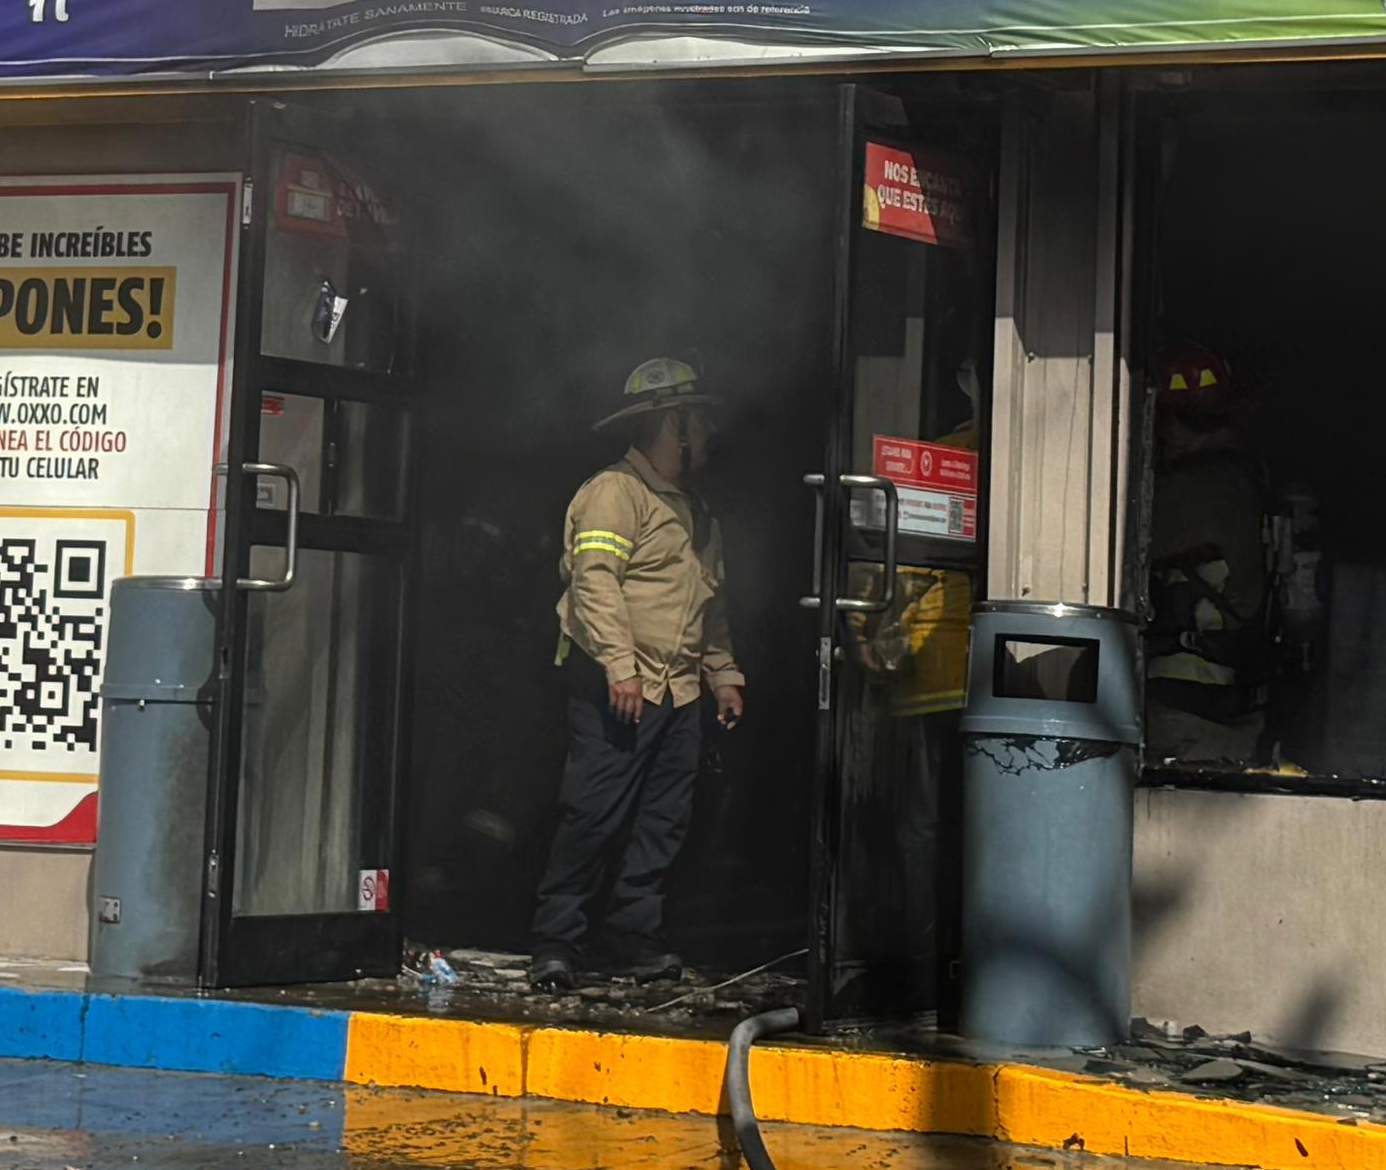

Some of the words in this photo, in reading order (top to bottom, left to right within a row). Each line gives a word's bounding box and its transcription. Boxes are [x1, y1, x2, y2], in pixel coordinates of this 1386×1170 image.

[364, 1, 467, 20] SANAMENTE
[884, 160, 908, 187] NOS
[877, 184, 901, 209] QUE
[30, 226, 152, 259] INCREÍBLES
[75, 375, 99, 398] EN
[34, 430, 54, 452] EL
[58, 425, 127, 453] CÓDIGO
[26, 458, 99, 480] CELULAR
